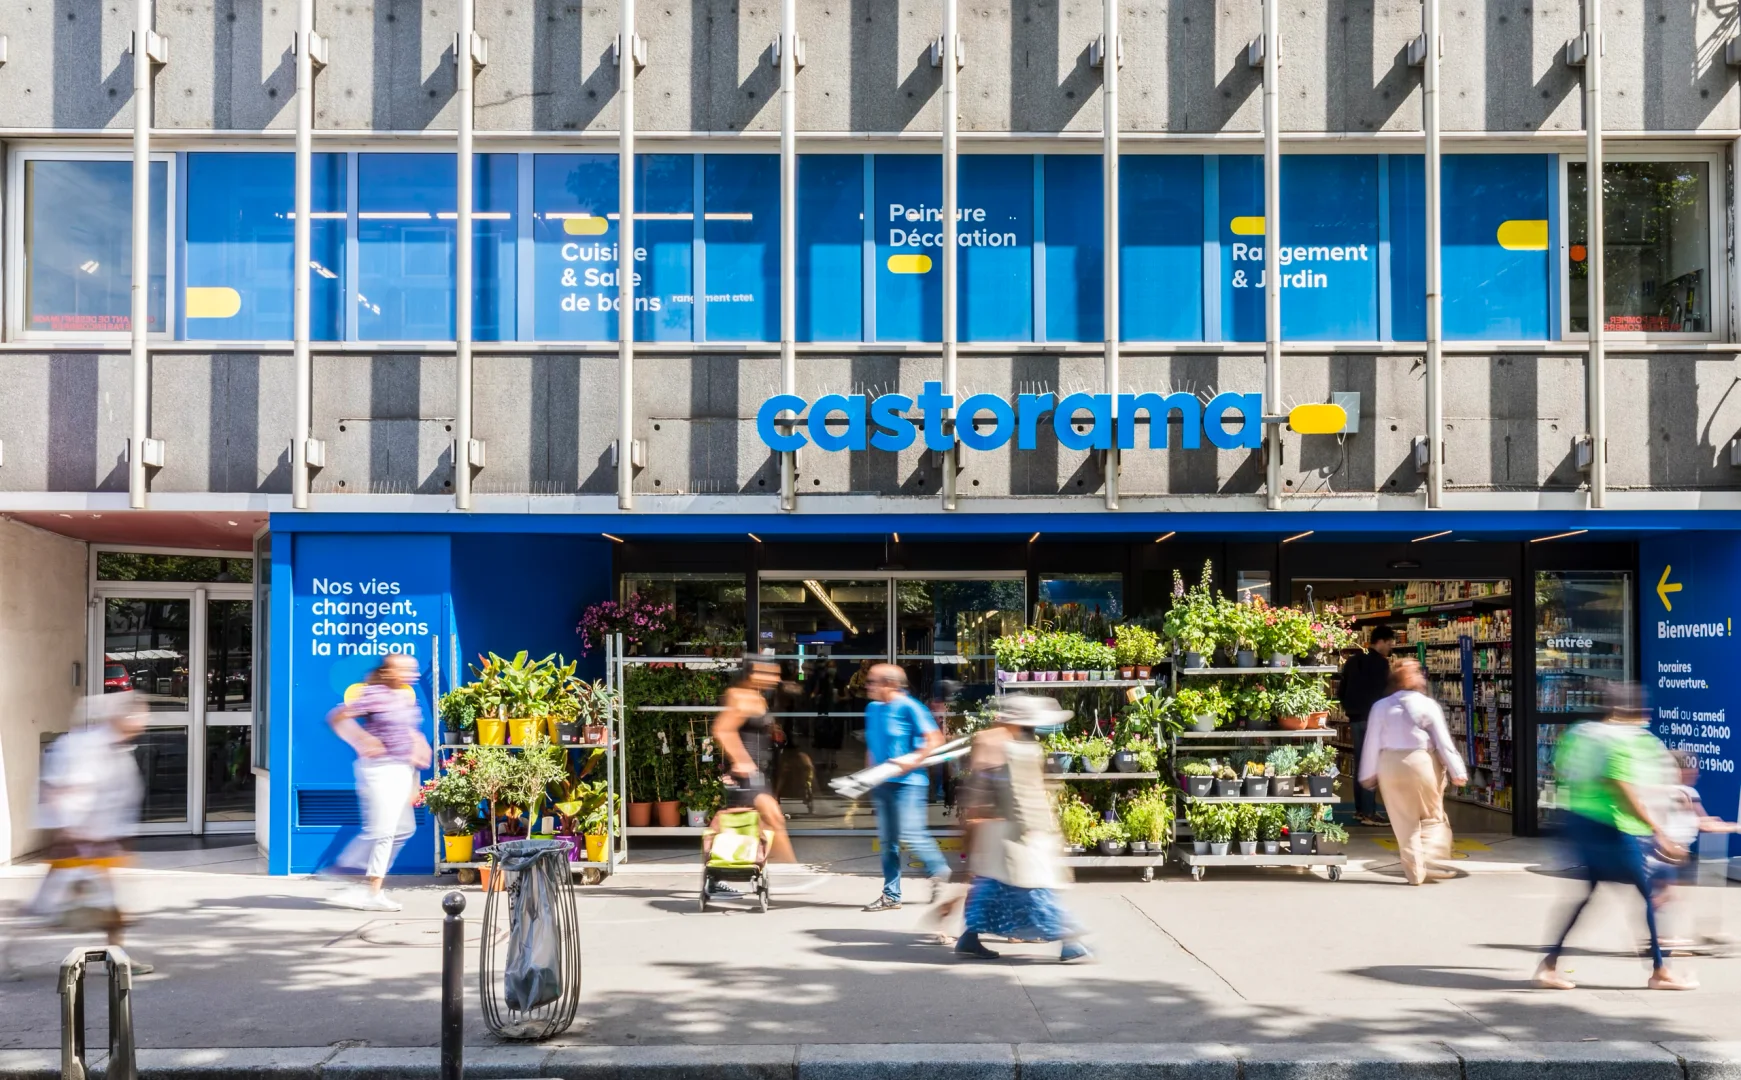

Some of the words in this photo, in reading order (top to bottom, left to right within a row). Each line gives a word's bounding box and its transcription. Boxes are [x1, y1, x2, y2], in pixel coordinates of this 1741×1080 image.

[889, 203, 986, 222] Peinre
[889, 228, 1017, 247] Décoation
[561, 242, 648, 262] Cuisie
[1232, 243, 1368, 265] Ragement
[561, 267, 578, 287] &
[584, 267, 642, 287] Sale
[1232, 269, 1248, 288] &
[1255, 269, 1328, 288] Jrdin
[561, 293, 591, 311] de
[597, 293, 661, 311] bans
[672, 294, 730, 304] rangment
[757, 381, 1263, 451] castorama
[313, 578, 353, 595] Nos
[359, 578, 400, 595] vies
[312, 598, 417, 619] changent,
[312, 618, 429, 639] changeons
[1658, 620, 1724, 638] Bienvenue
[312, 639, 331, 655] la
[337, 639, 415, 655] maison
[1546, 636, 1593, 648] entrée
[1658, 660, 1692, 673] horaires
[1658, 706, 1679, 719] lundi
[1680, 710, 1691, 720] au
[1692, 708, 1725, 722] samedi
[1659, 722, 1670, 735] de
[1670, 723, 1693, 736] 9h00
[1693, 724, 1700, 737] à
[1701, 725, 1731, 740] 20h00
[1668, 738, 1676, 751] le
[1677, 739, 1721, 755] dimanche
